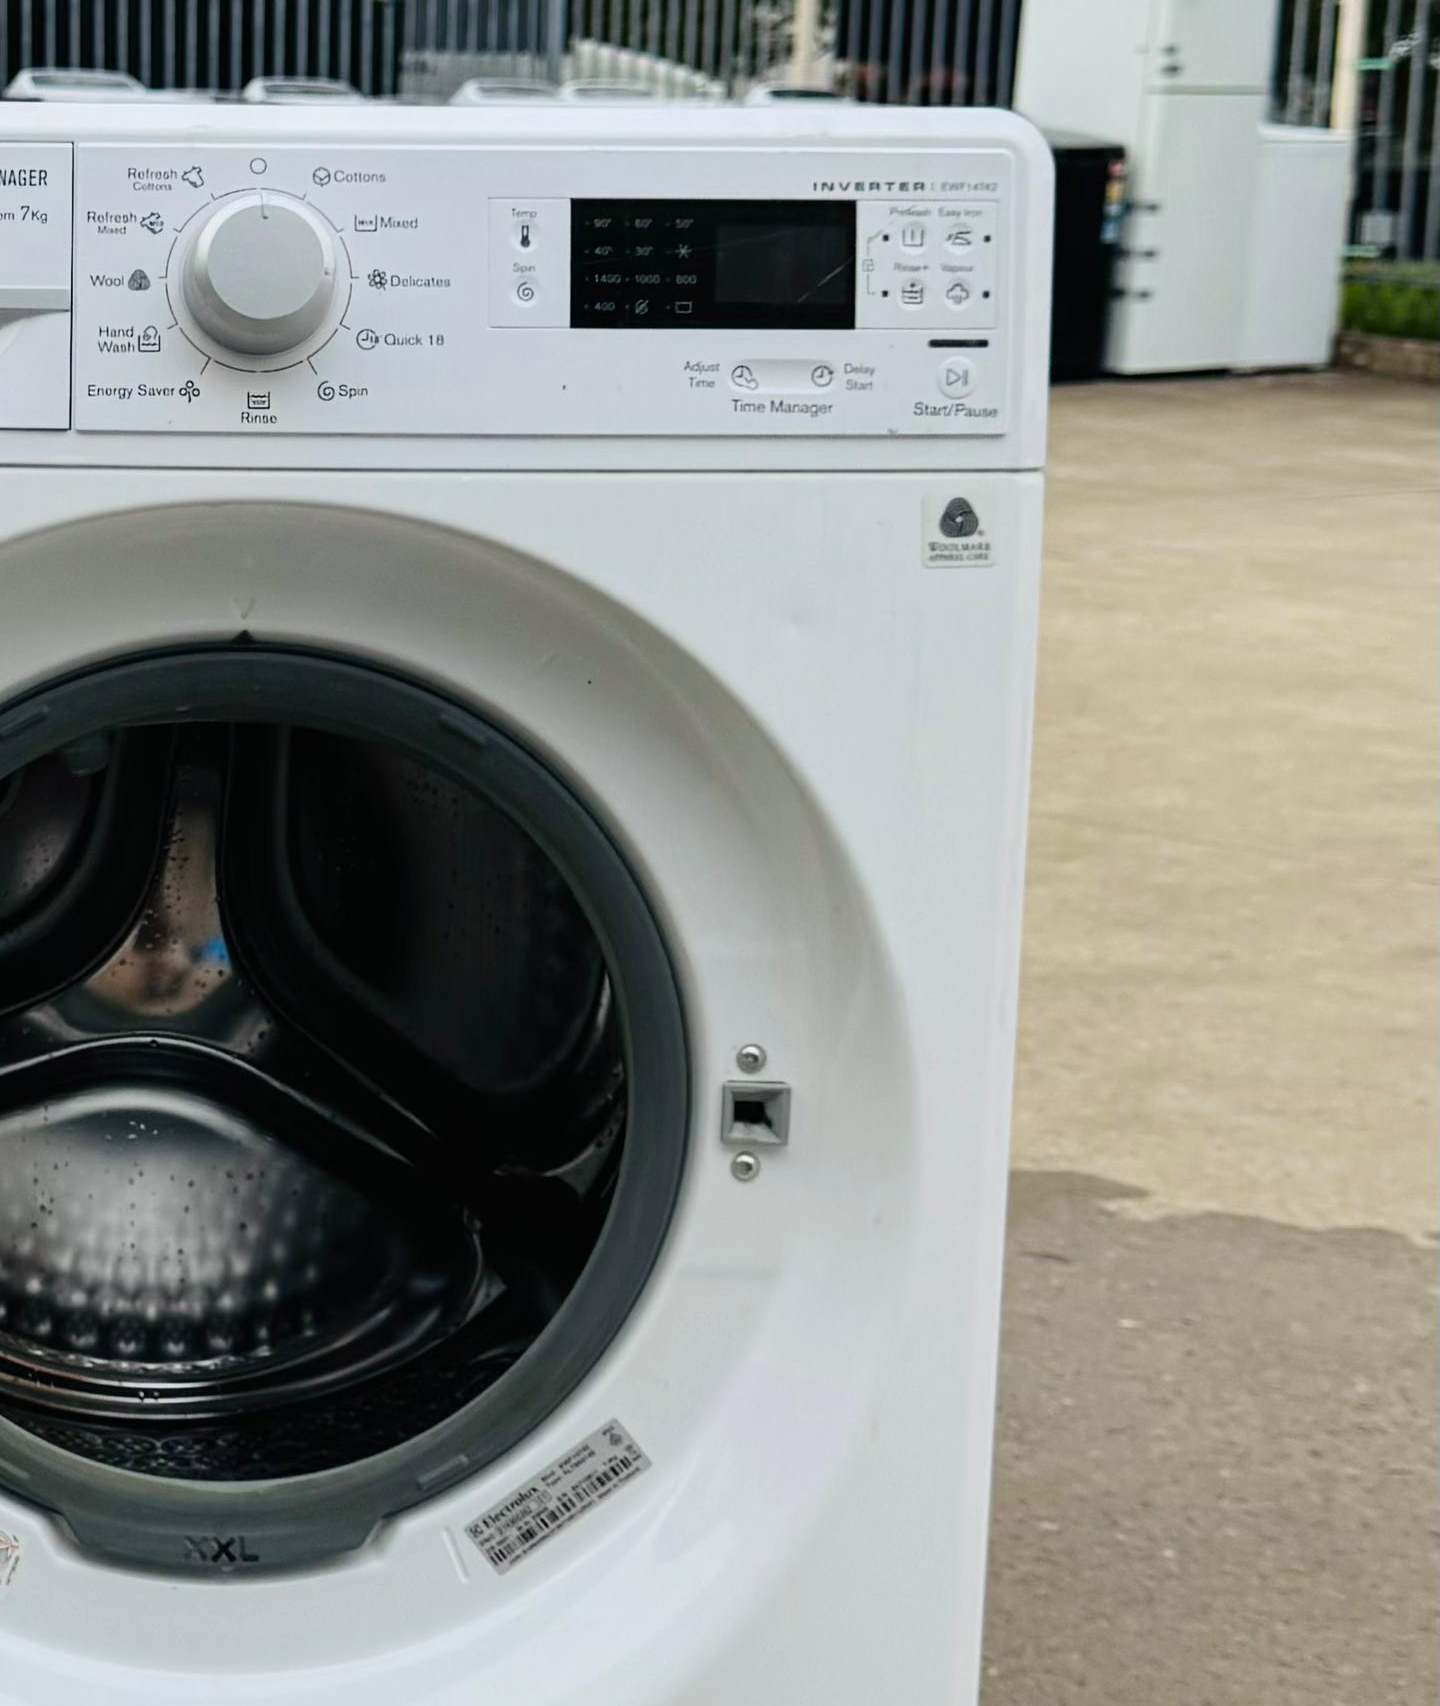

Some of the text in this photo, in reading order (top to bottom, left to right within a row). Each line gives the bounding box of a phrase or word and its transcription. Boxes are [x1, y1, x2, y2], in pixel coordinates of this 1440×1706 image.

[128, 168, 177, 180] Refresh
[334, 170, 386, 183] Cottons
[133, 181, 172, 191] Cottons
[813, 182, 925, 192] INVERTER
[87, 211, 137, 223] Refresh
[511, 208, 537, 219] Temp
[380, 216, 418, 229] Mixed
[97, 226, 127, 235] Mixed
[513, 263, 536, 274] Spin
[90, 274, 125, 287] Wool
[390, 275, 451, 288] Delicates
[98, 326, 134, 338] Hand
[384, 333, 444, 346] Quick 18
[98, 341, 135, 353] Wash
[684, 361, 720, 375] Adjust
[843, 364, 876, 377] Delay
[688, 377, 715, 389] Time
[845, 380, 873, 391] Start
[87, 384, 175, 399] Energy Saver
[338, 384, 368, 399] Spin
[731, 399, 833, 418] Time Manager
[913, 402, 998, 419] Start/Pause
[240, 411, 278, 425] Rinse
[183, 1535, 260, 1563] XXL
